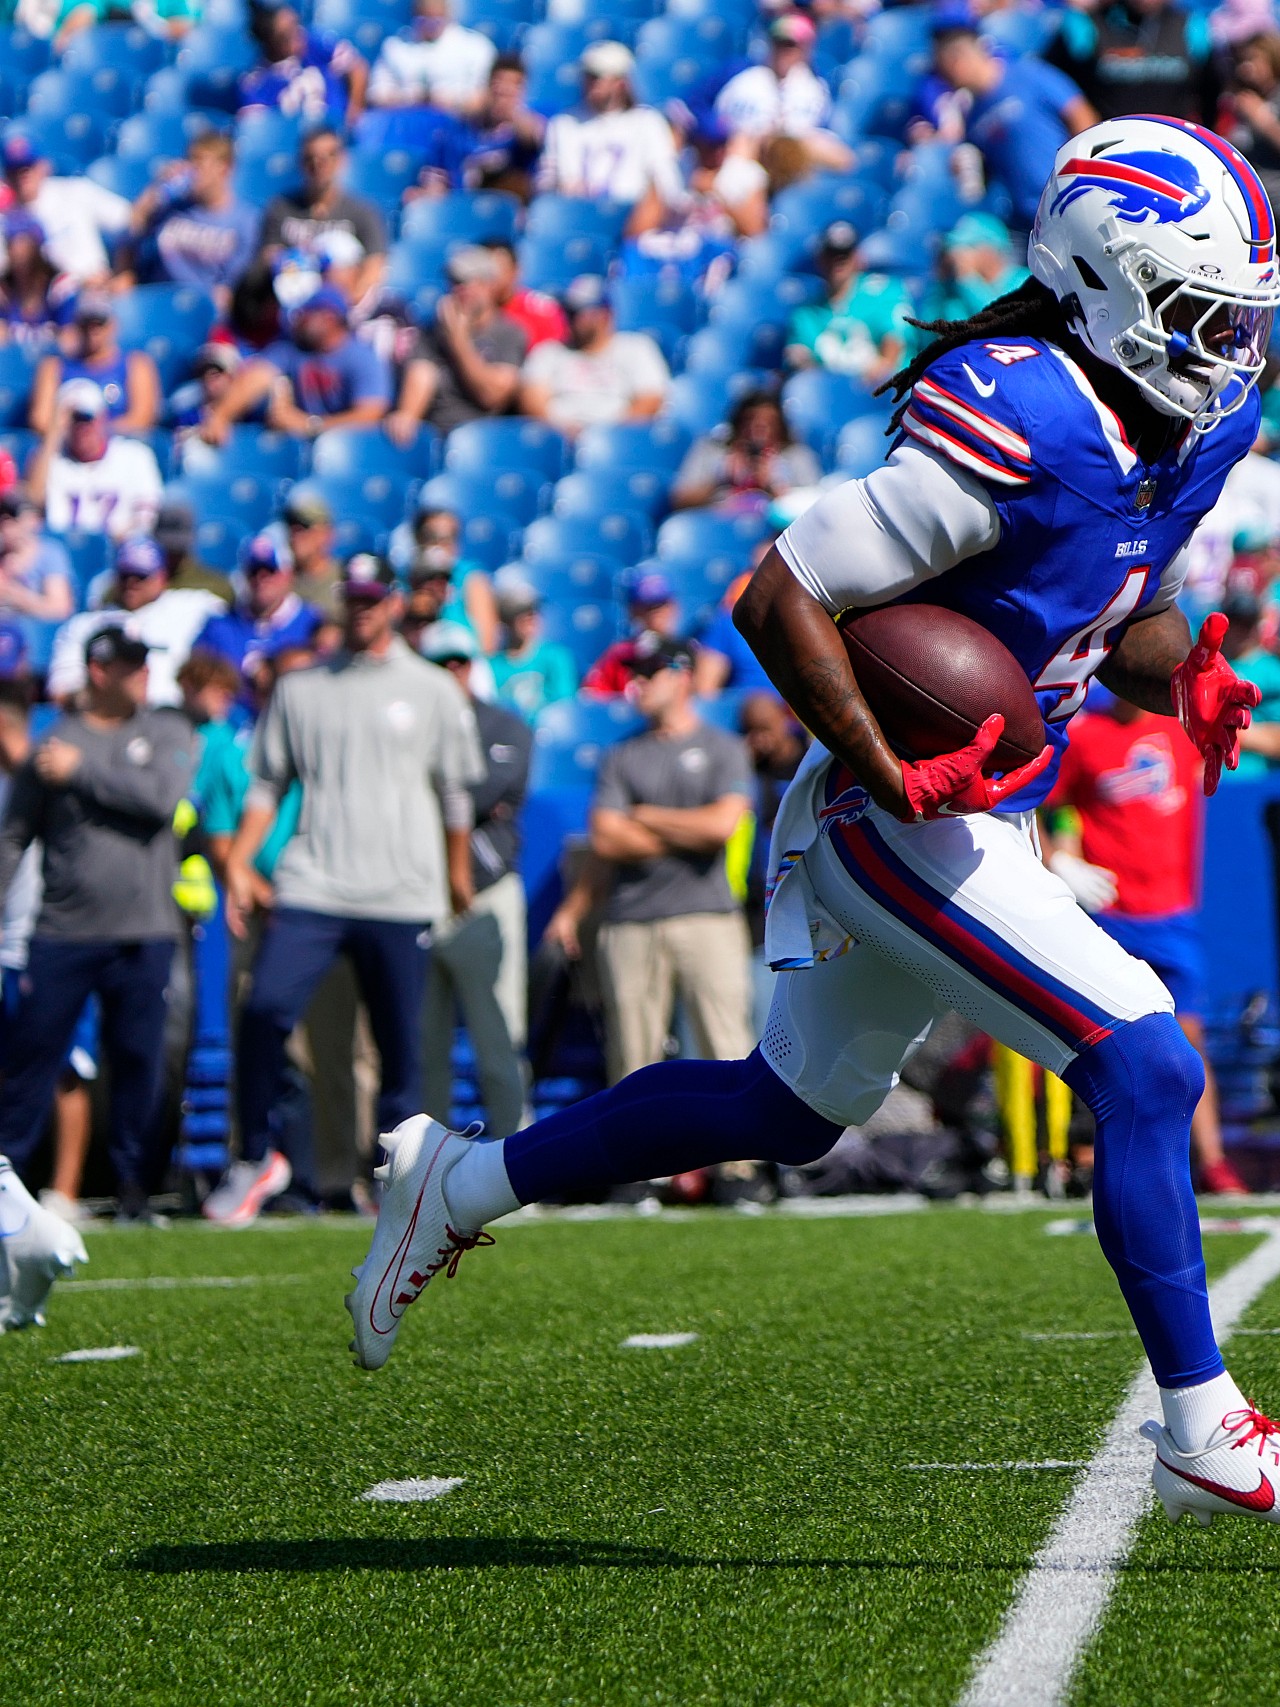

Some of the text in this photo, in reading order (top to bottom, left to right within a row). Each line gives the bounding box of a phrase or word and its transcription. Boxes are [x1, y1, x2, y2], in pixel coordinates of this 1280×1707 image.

[1190, 268, 1225, 281] OAKLEY
[983, 343, 1041, 367] 4
[1114, 539, 1148, 558] BILLS
[1032, 564, 1152, 724] 4
